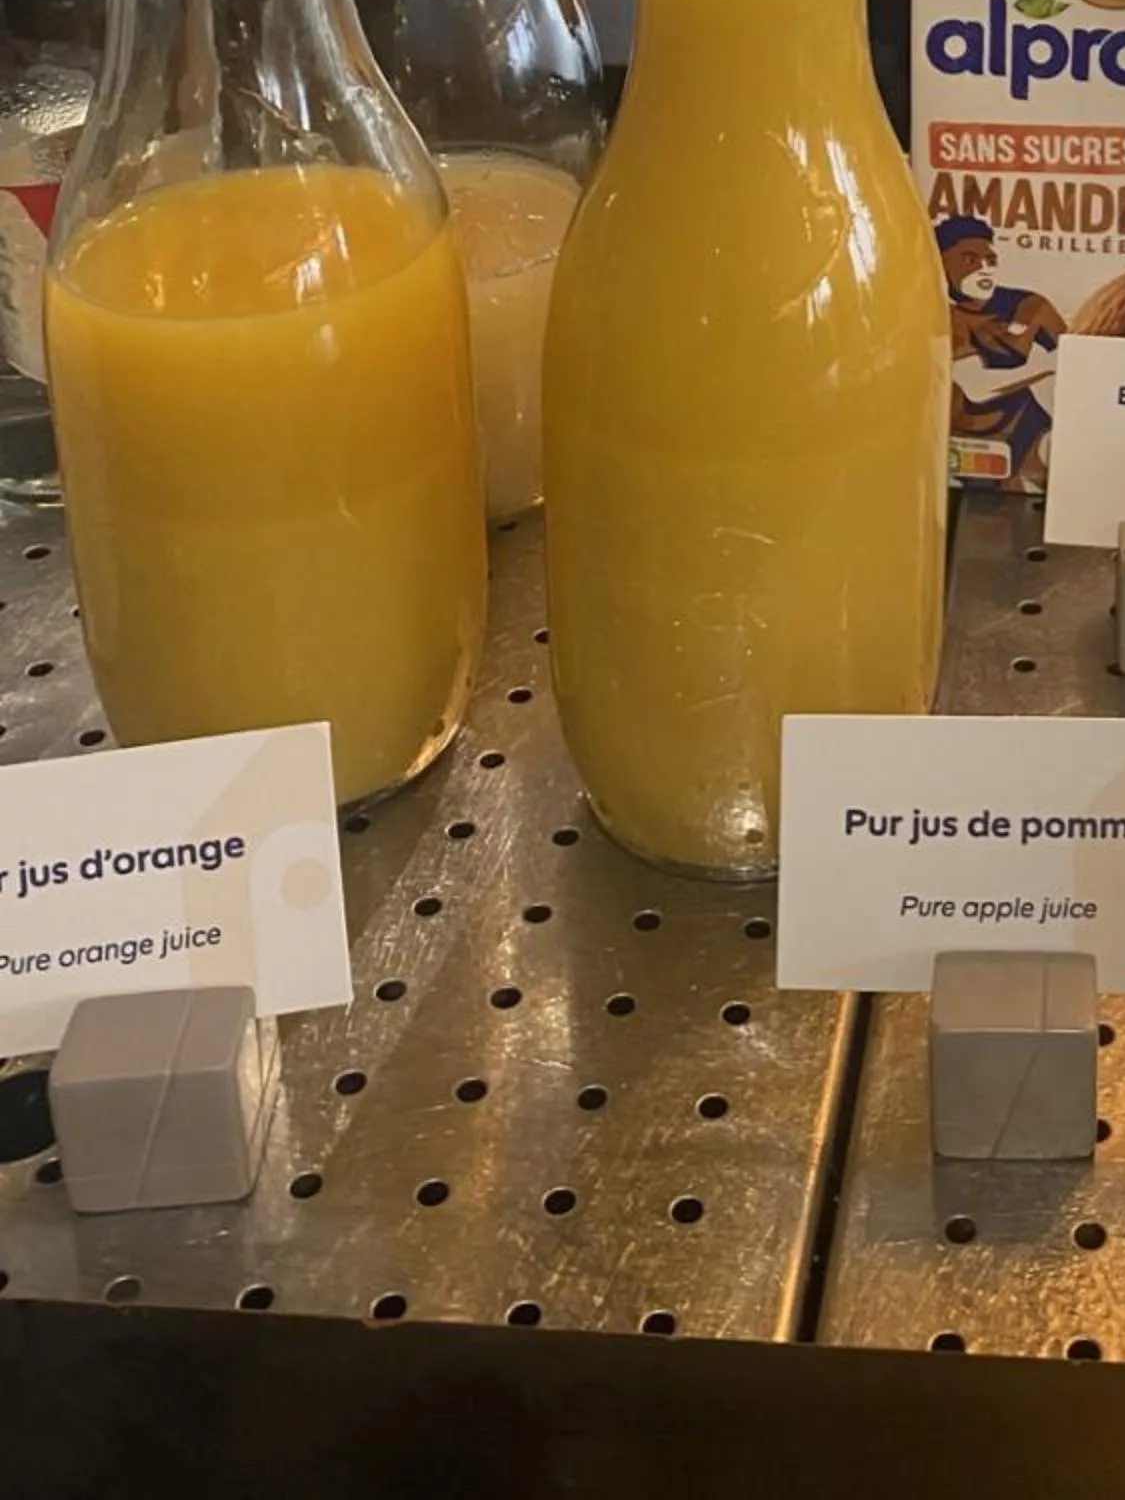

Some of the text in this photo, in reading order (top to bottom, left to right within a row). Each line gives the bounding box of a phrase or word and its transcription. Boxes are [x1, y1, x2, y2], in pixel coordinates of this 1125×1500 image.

[939, 132, 1015, 164] SANS
[845, 809, 903, 837] Pur
[908, 809, 958, 844] jus
[967, 810, 1011, 839] de
[17, 860, 69, 899] jus
[900, 896, 1098, 923] Pure apple juice
[58, 936, 154, 967] orange
[159, 925, 221, 959] juice
